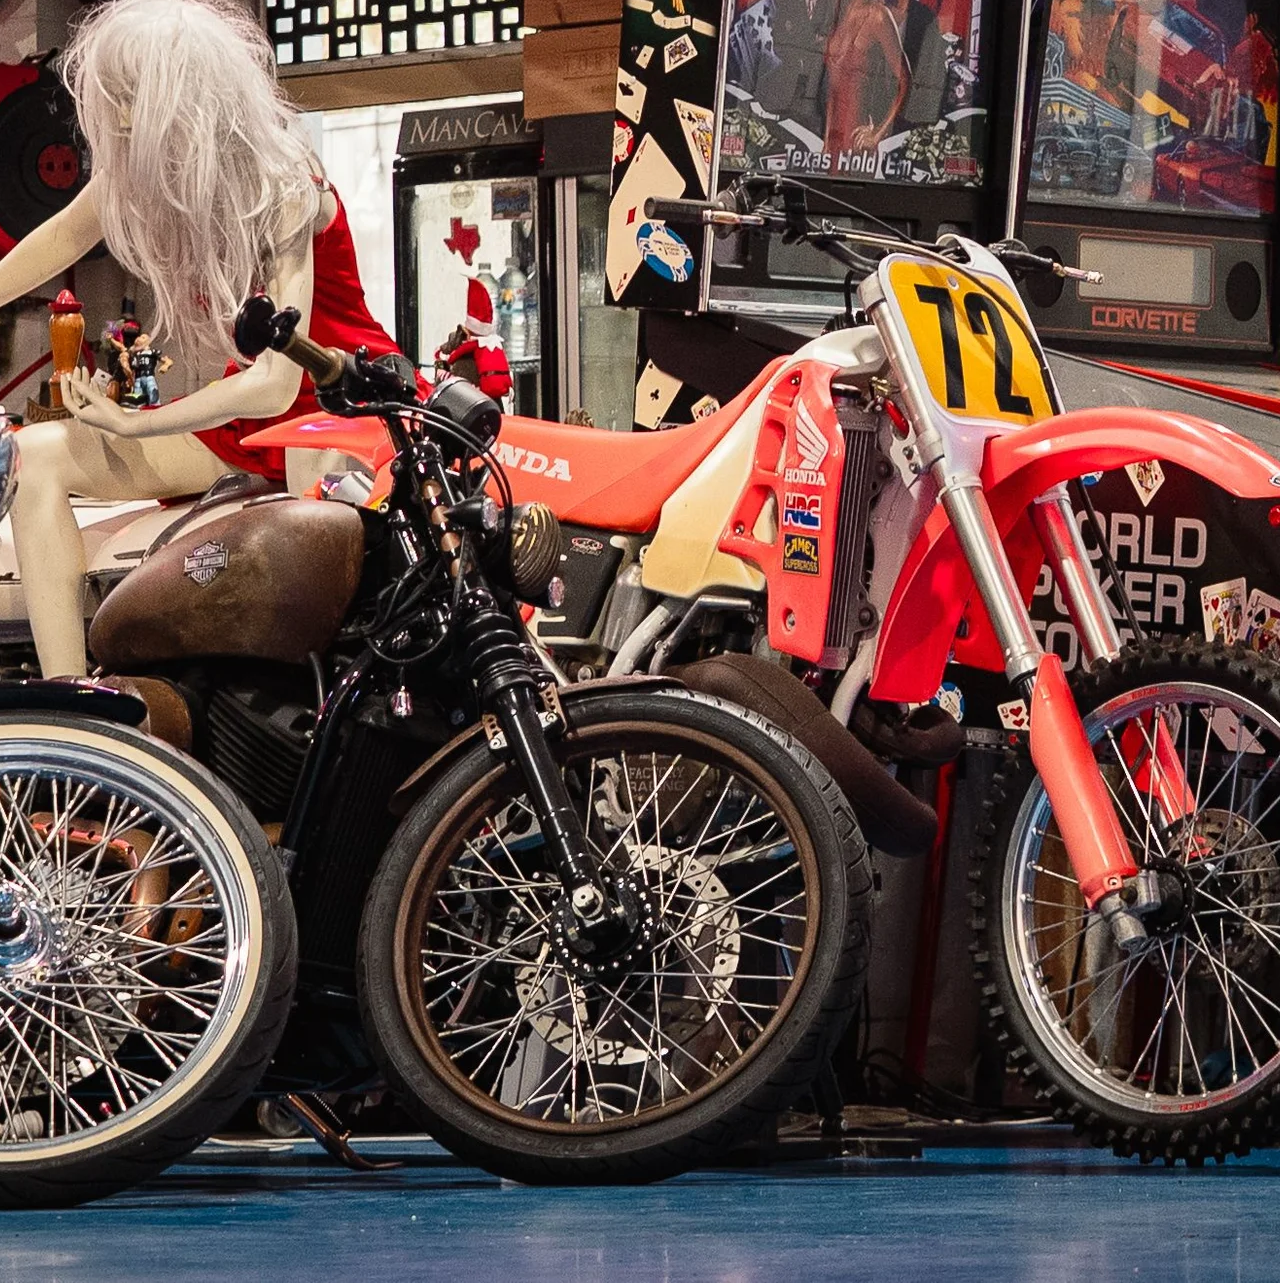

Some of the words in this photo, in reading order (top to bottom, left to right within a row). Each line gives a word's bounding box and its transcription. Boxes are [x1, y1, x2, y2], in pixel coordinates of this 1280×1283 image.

[783, 143, 832, 170] Texas
[837, 149, 877, 172] Hold
[1091, 305, 1198, 334] CORVETTE
[914, 283, 1034, 417] 72
[784, 468, 827, 487] HONDA
[784, 536, 818, 561] CAMEL
[1072, 511, 1208, 569] ORLD
